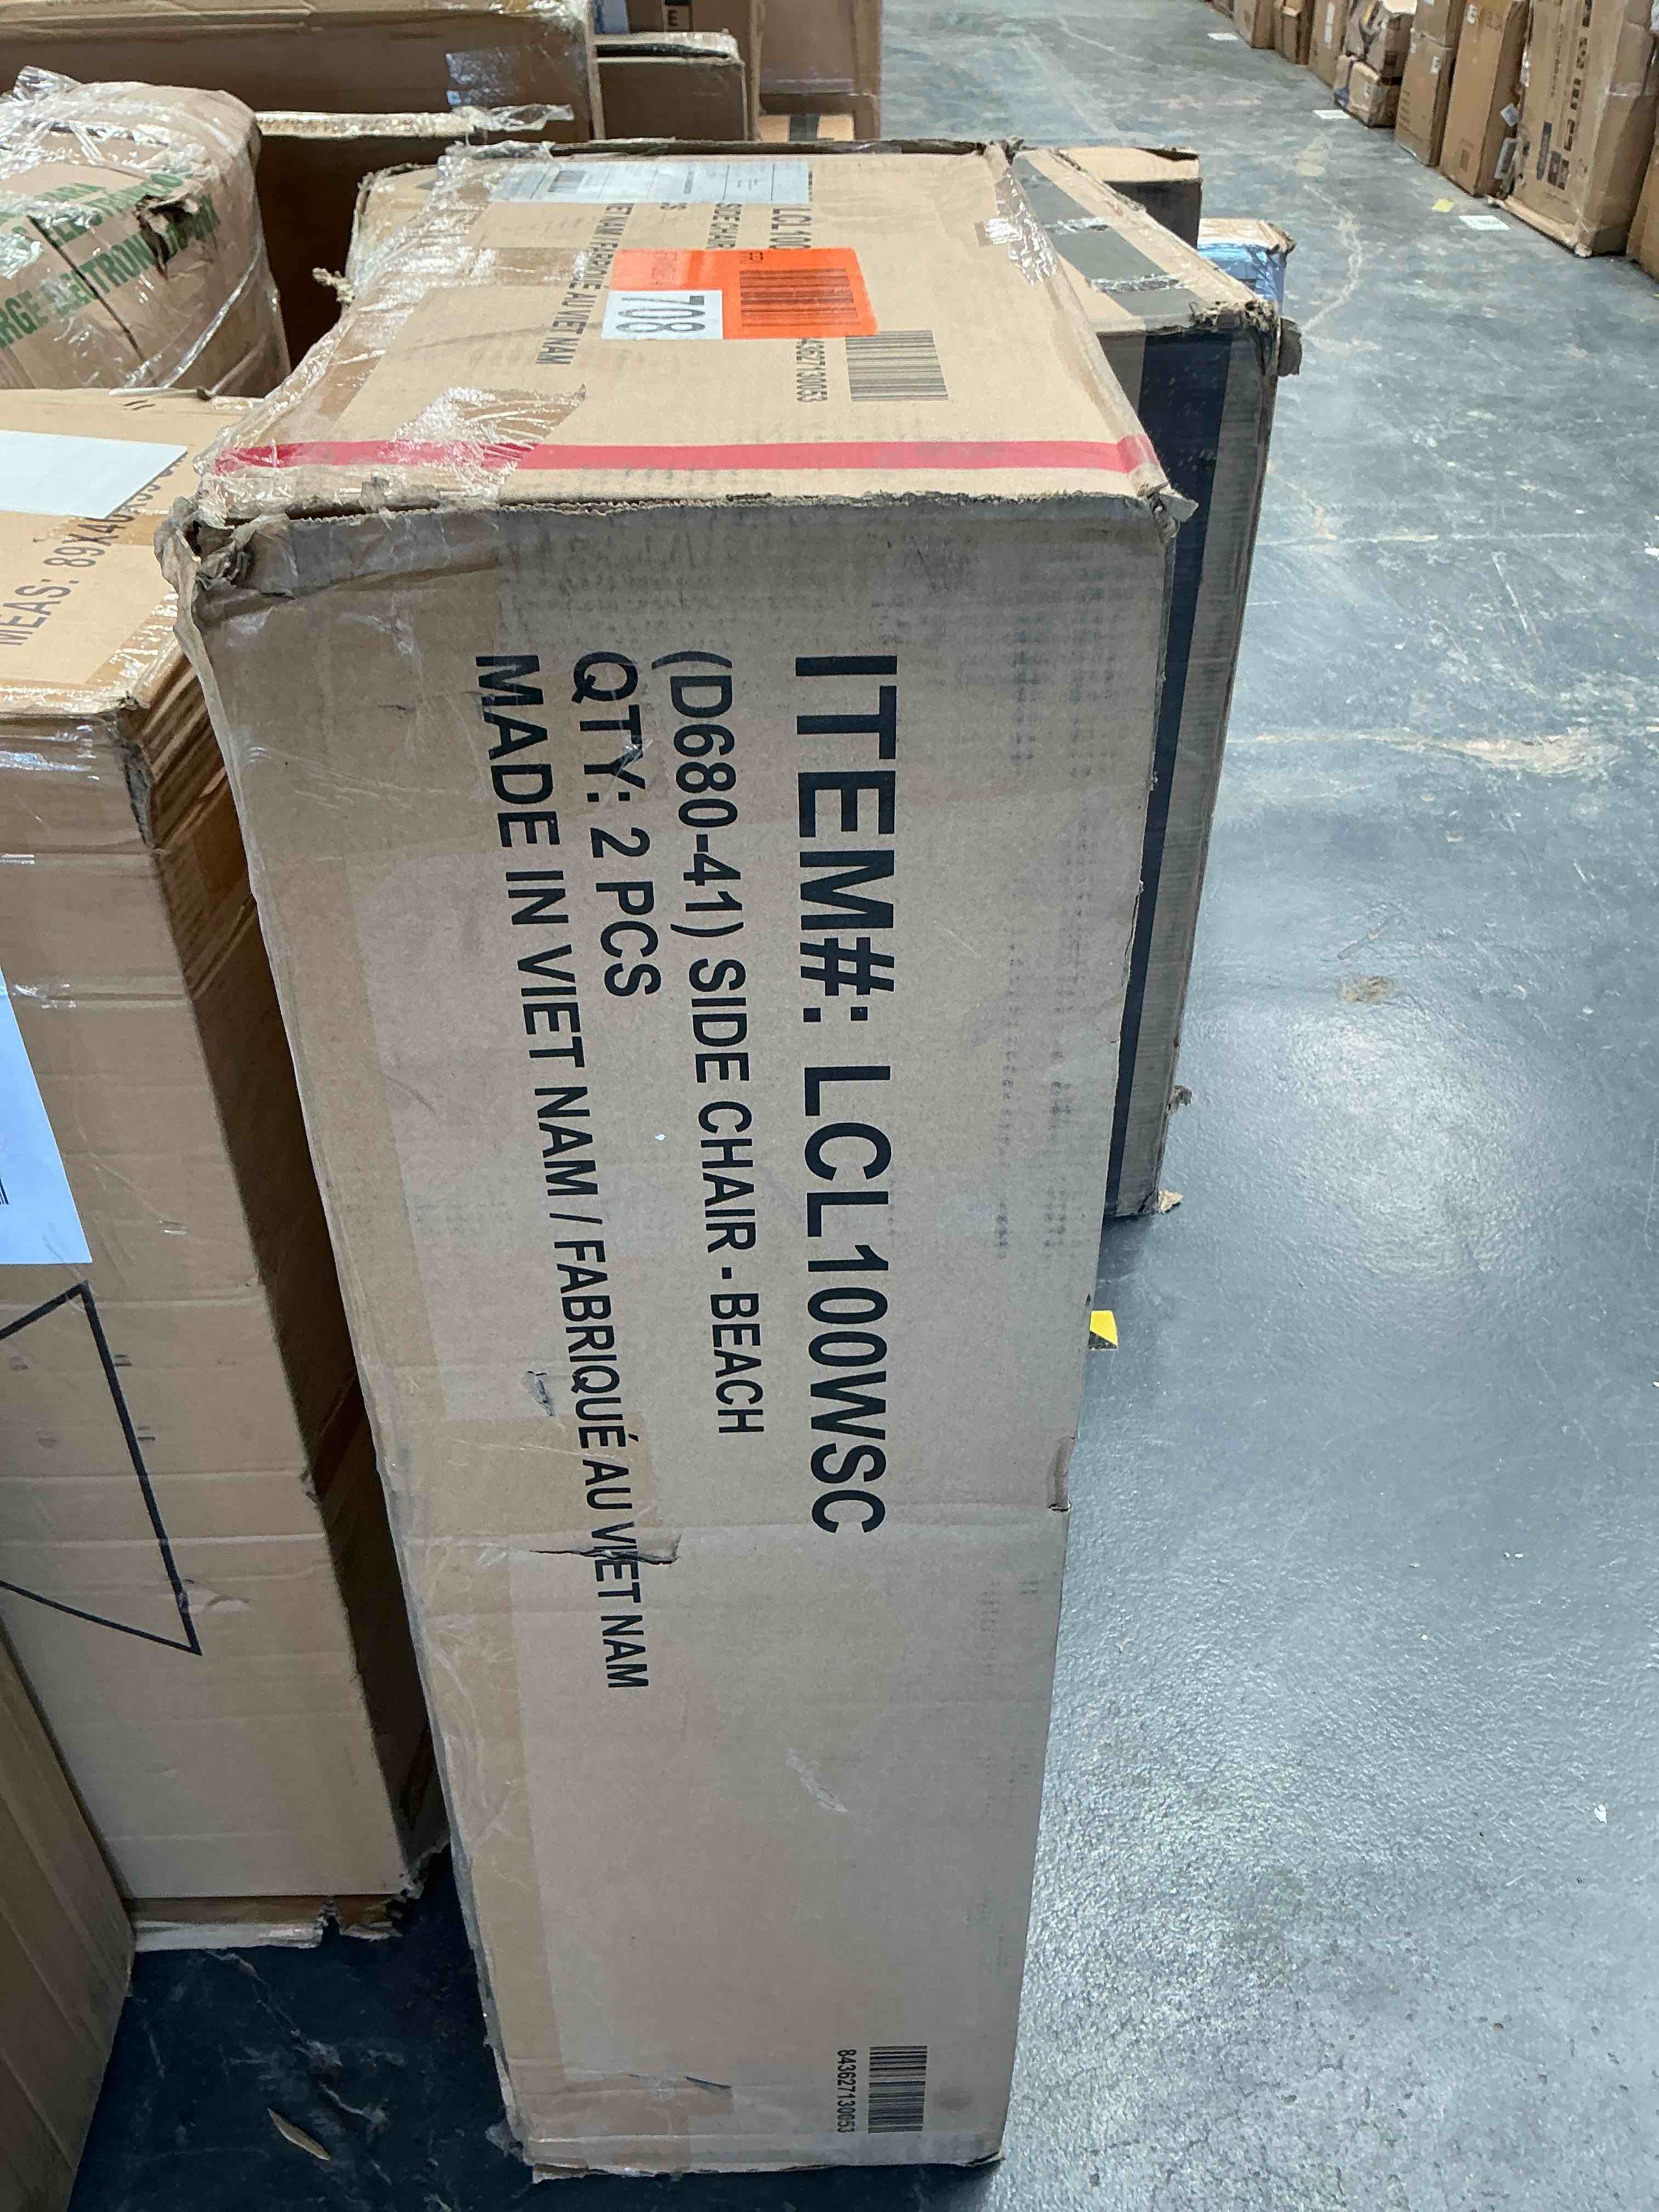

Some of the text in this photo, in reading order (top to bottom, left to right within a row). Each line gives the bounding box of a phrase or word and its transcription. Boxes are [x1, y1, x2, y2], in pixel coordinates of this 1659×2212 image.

[615, 294, 707, 333] 708
[571, 651, 662, 997] QTY: 2 PCS
[652, 650, 744, 938] (D680-41)
[689, 958, 749, 1083] SIDE
[795, 655, 898, 1534] ITEM#: LCL100WSC
[475, 655, 649, 1688] MADE IN VIET NAM / FABRIQUÉ AU VIET NAM
[698, 1101, 756, 1253] CHAIR
[710, 1293, 764, 1433] BEACH
[837, 2049, 857, 2134] 843627130053
